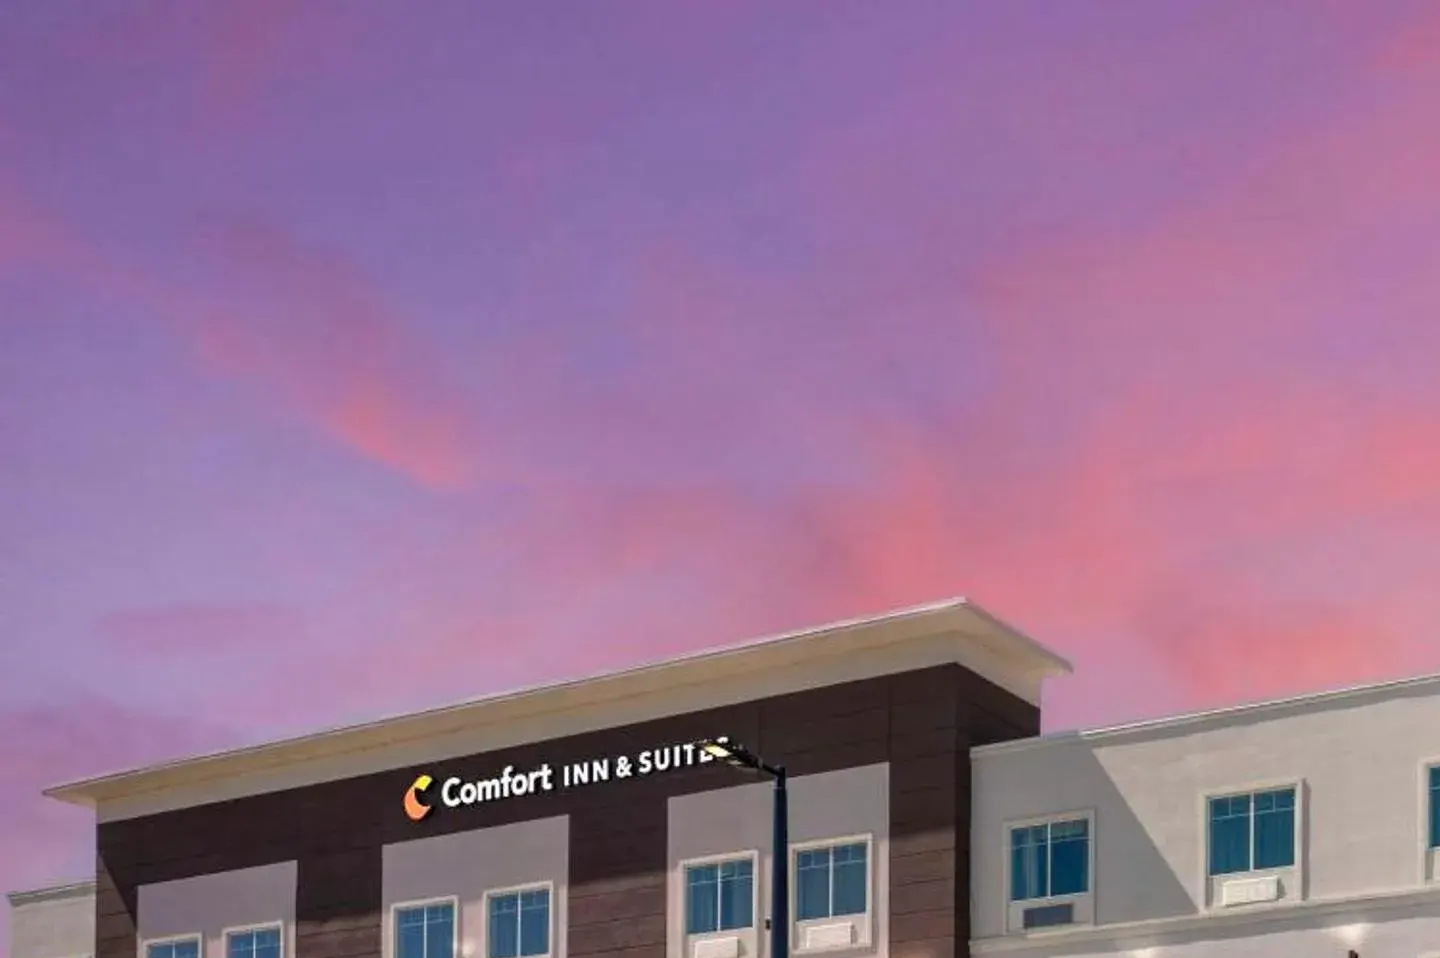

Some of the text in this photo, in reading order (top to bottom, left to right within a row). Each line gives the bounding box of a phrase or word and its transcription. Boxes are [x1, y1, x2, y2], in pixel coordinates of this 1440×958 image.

[442, 764, 552, 807] Comfort
[564, 760, 609, 787] INN
[615, 756, 633, 778] &
